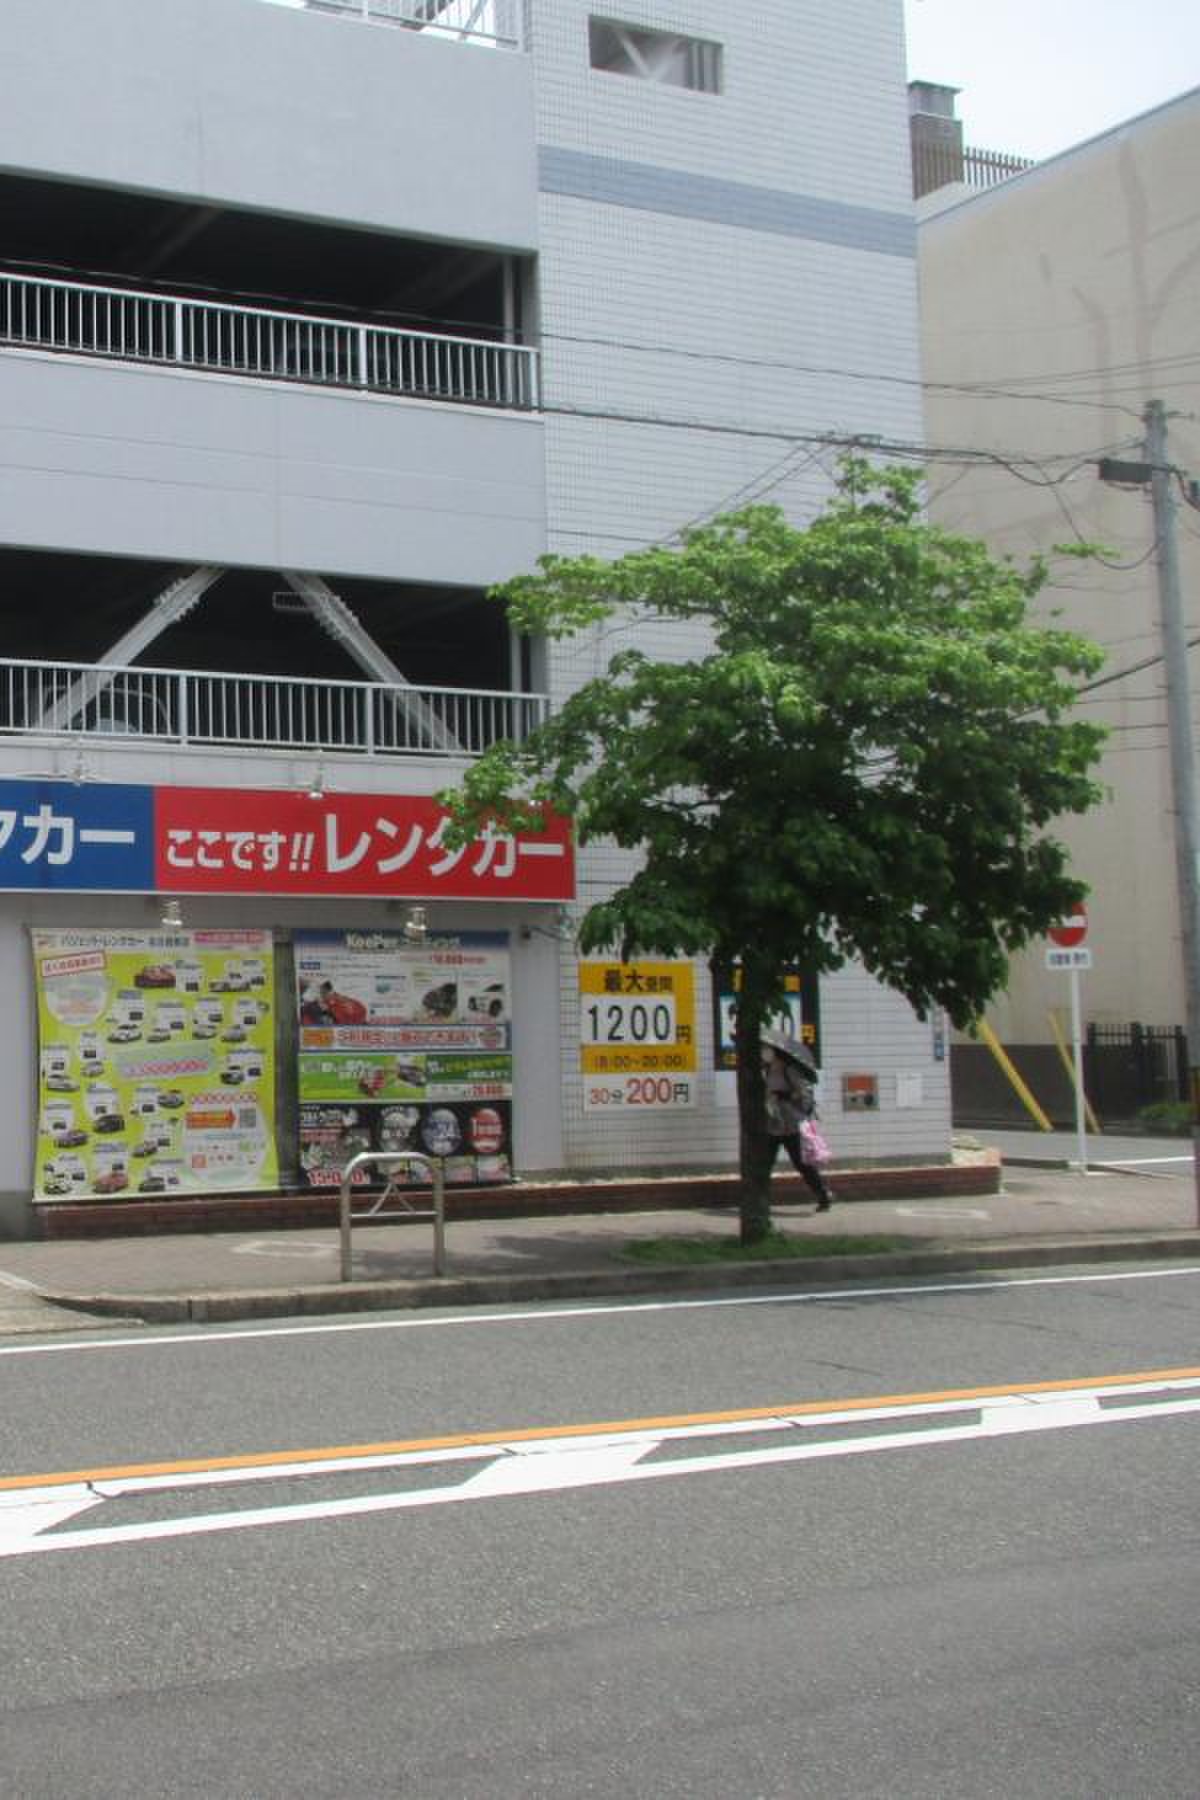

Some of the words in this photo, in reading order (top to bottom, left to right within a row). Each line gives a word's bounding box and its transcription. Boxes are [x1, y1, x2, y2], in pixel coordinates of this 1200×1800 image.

[325, 813, 565, 877] レンタカー
